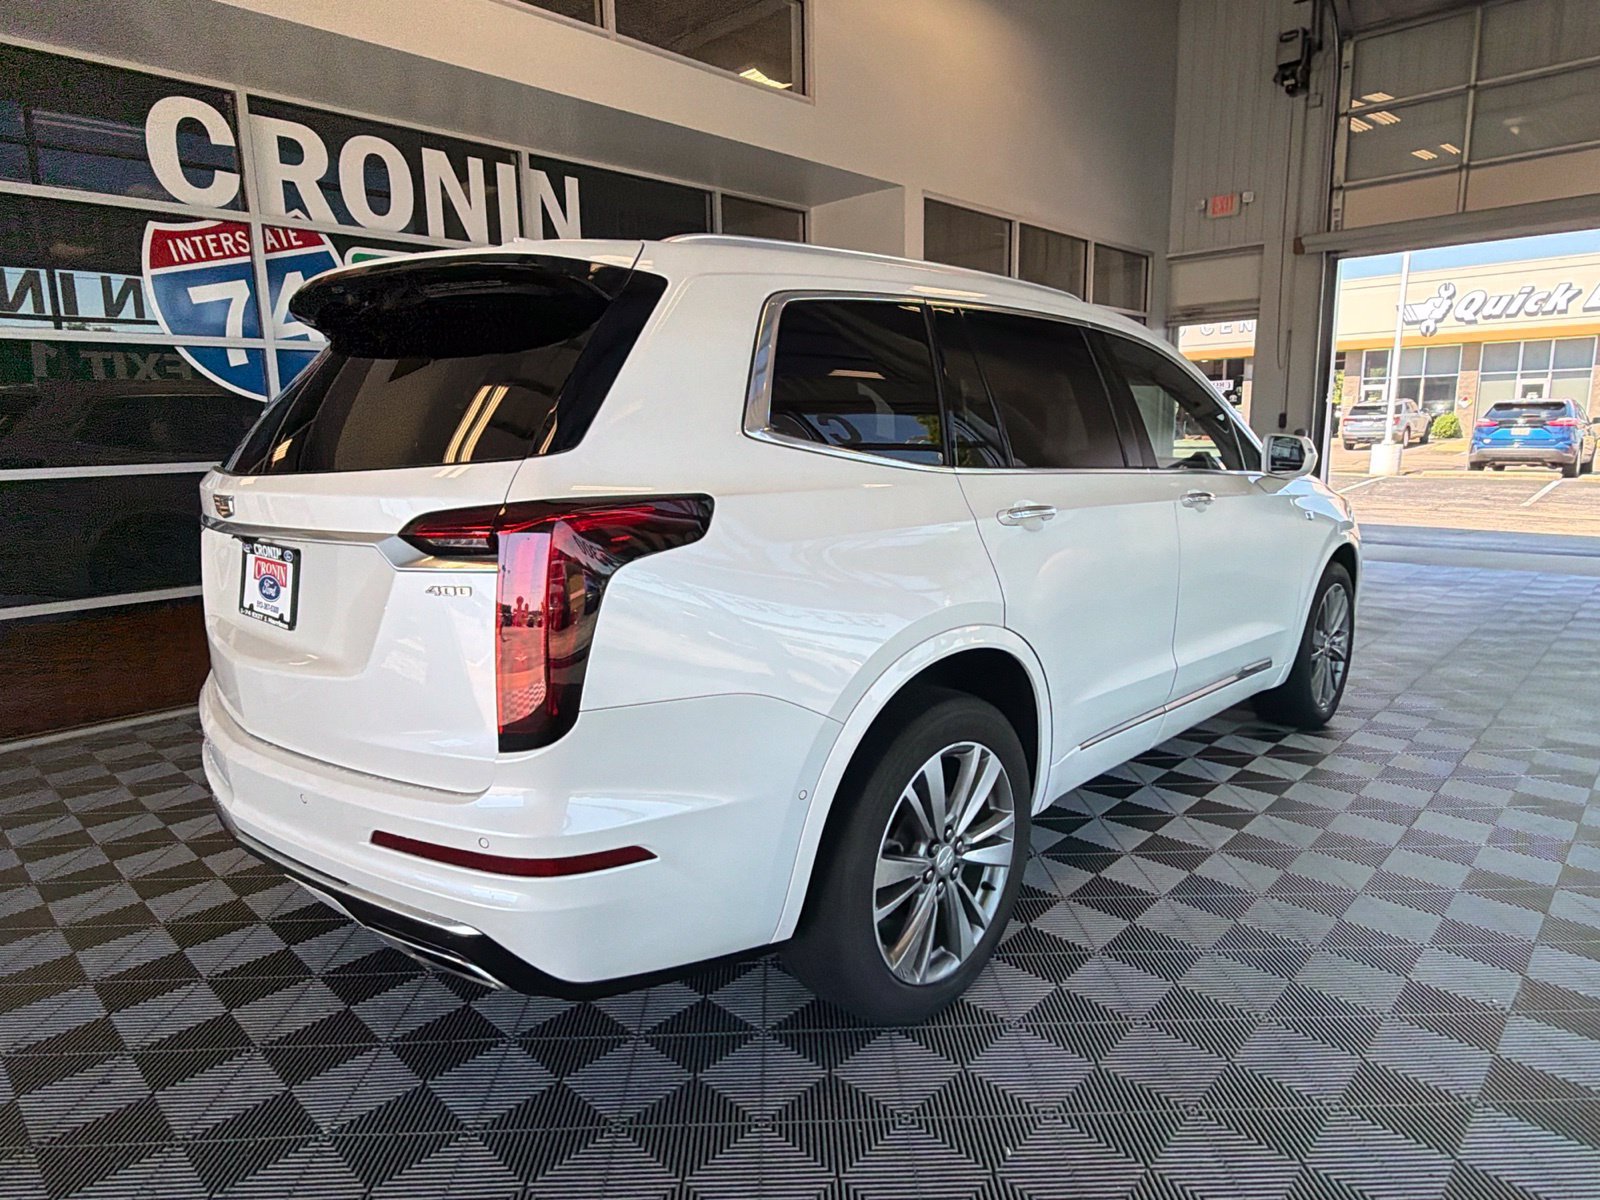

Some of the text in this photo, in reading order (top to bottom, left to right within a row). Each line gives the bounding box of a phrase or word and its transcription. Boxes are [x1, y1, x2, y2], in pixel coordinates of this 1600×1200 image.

[145, 95, 582, 245] CRONIN
[1211, 194, 1235, 216] EXIT
[167, 227, 304, 263] INTERSATE
[1453, 282, 1583, 325] Quick
[255, 560, 287, 588] CRONIN
[425, 585, 473, 597] 400
